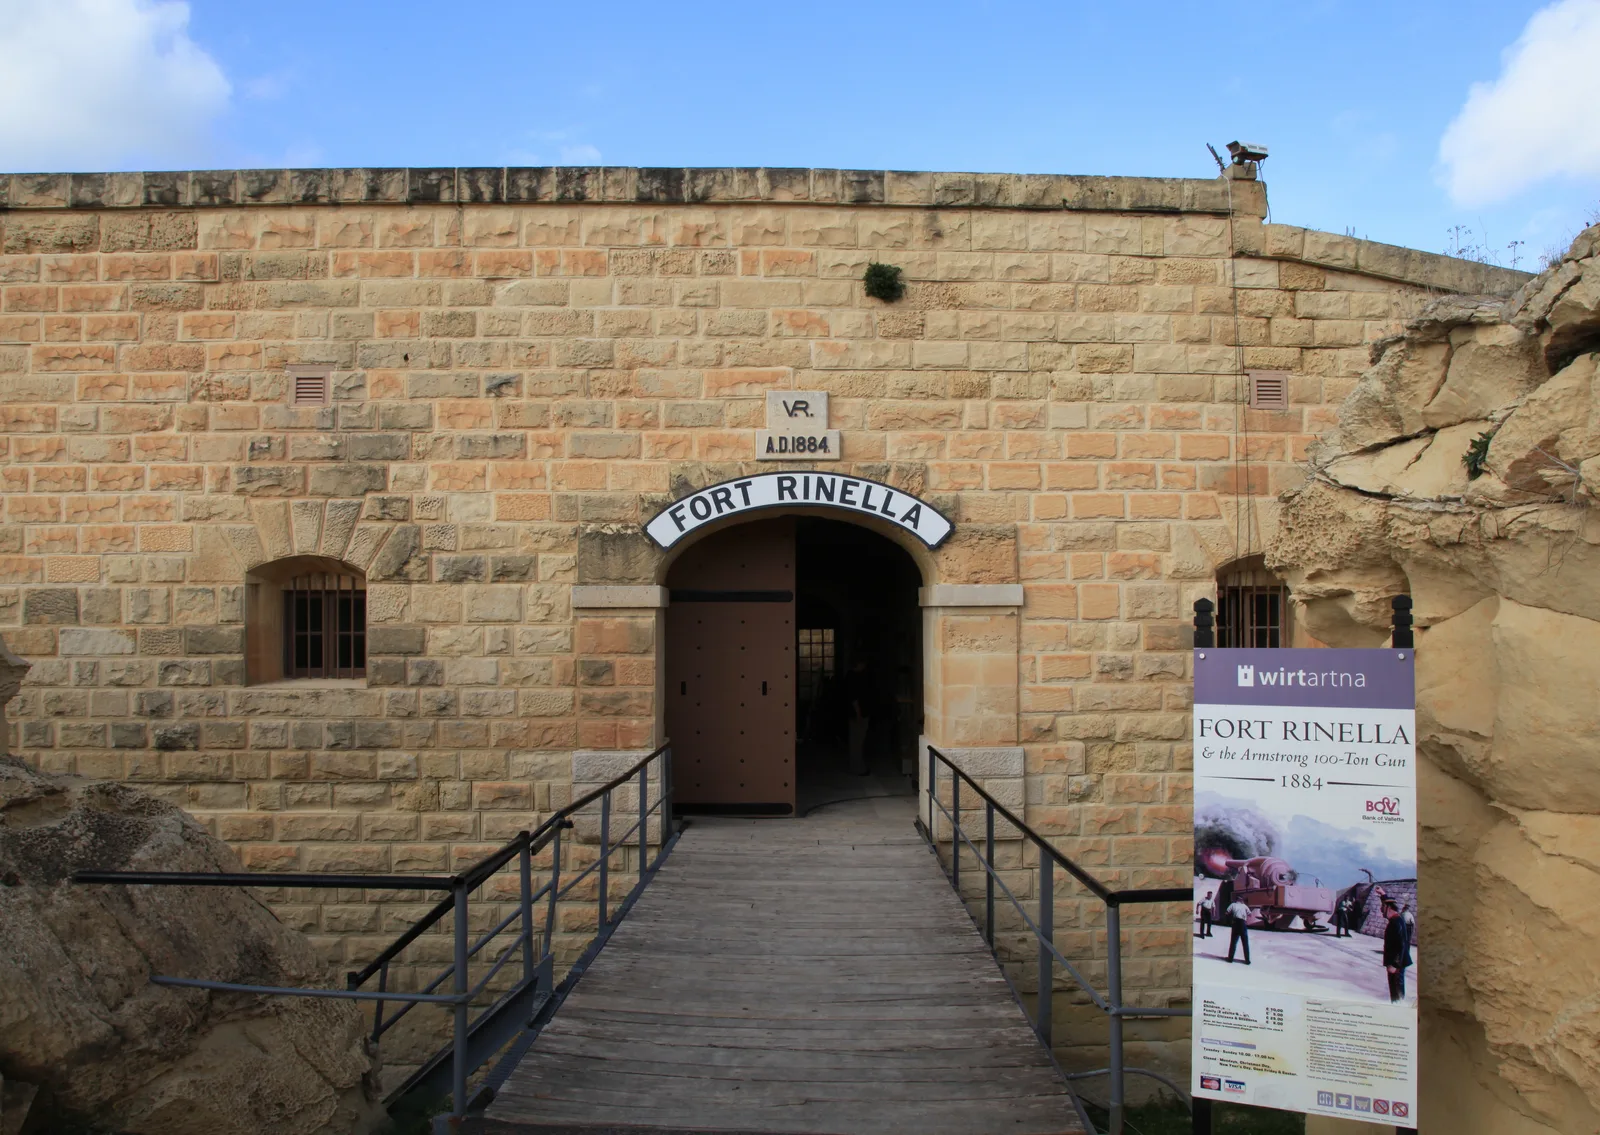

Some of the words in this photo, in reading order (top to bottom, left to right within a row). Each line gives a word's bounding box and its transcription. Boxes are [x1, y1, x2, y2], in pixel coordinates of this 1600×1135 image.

[668, 480, 752, 532] FORT
[777, 475, 922, 530] RINELLA
[1259, 667, 1365, 688] wirtartna
[1199, 718, 1272, 739] FORT
[1282, 721, 1411, 745] RINELLA
[1202, 746, 1215, 759] &
[1220, 747, 1237, 760] the
[1240, 748, 1308, 767] Armstrong
[1314, 752, 1368, 766] 100-Ton
[1375, 753, 1406, 767] Gun
[1281, 774, 1323, 790] 1884
